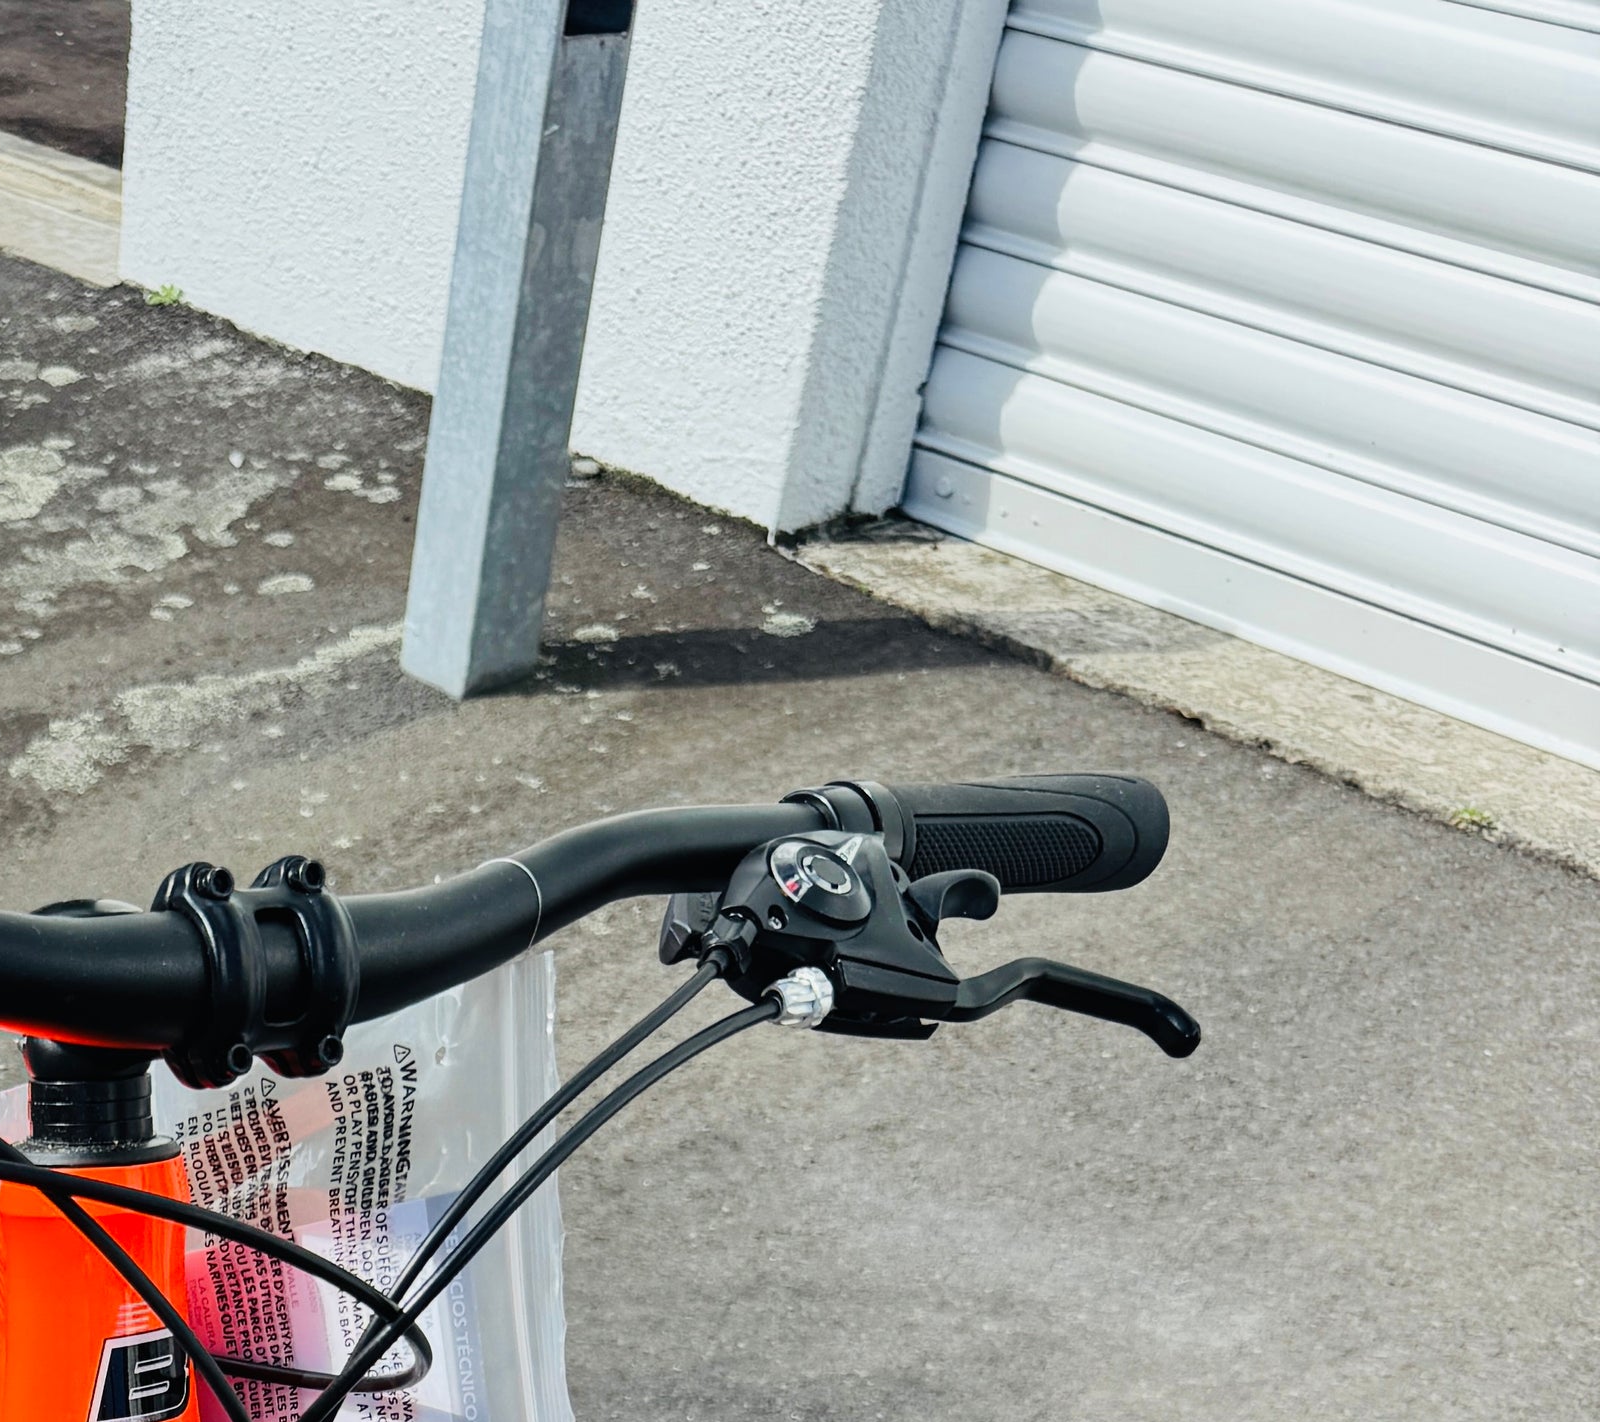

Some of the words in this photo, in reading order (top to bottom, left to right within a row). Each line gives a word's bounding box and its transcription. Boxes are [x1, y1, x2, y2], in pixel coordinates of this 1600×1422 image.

[325, 1080, 344, 1113] AND
[342, 1074, 359, 1096] OR
[348, 1099, 361, 1138] PLAY
[330, 1115, 345, 1185] PREVENT
[186, 1116, 198, 1135] EN
[204, 1250, 229, 1312] NARINES
[373, 1212, 388, 1232] OF
[343, 1216, 357, 1255] THIN
[233, 1243, 247, 1266] OU
[250, 1250, 267, 1275] PAS
[361, 1250, 373, 1272] DO
[240, 1268, 256, 1294] LES
[200, 1296, 216, 1349] CALERA
[247, 1296, 264, 1344] PARCS
[258, 1278, 277, 1342] UTILISER
[351, 1300, 364, 1330] MAY
[338, 1318, 354, 1347] BAG
[274, 1386, 286, 1412] LES
[356, 1402, 369, 1412] A
